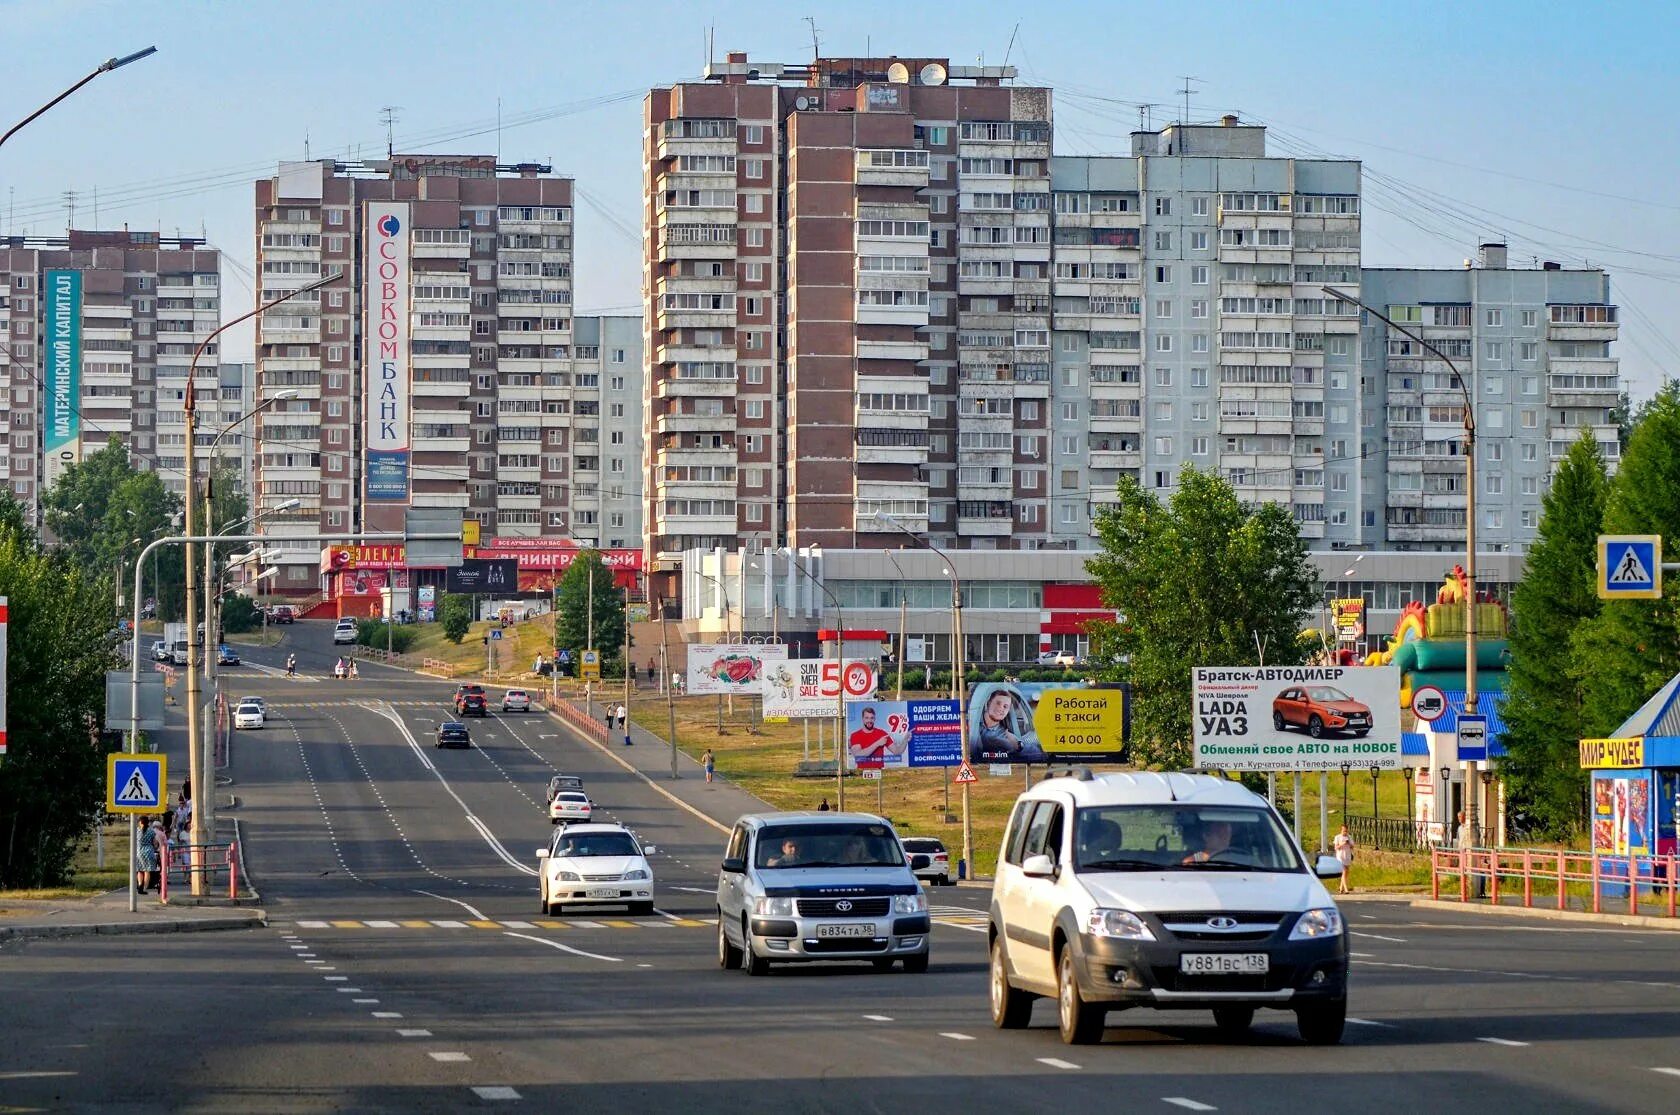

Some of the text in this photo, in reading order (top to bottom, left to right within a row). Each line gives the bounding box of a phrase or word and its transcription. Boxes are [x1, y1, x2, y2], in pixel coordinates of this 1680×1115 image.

[56, 275, 72, 338] КАПИТАЛ
[378, 241, 399, 440] СОВКОМБАНК
[54, 342, 71, 438] МАТЕРИНСКИЙ
[800, 663, 818, 674] SUM
[801, 675, 818, 685] MER
[1197, 669, 1344, 683] Братск-АВТОДИЛЕР
[800, 686, 818, 697] SALE
[913, 705, 952, 713] ОДОБРЯЕМ
[1055, 697, 1107, 710] Работай
[1199, 701, 1247, 715] LADA
[1066, 714, 1100, 722] такси
[1201, 717, 1249, 736] УАЗ
[1200, 743, 1397, 755] Обменяй свое АВТО на НОВОЕ
[1581, 741, 1640, 765] МИР ЧУДЕС
[821, 926, 860, 936] В834ТА
[1186, 955, 1265, 970] У881ВС 138
